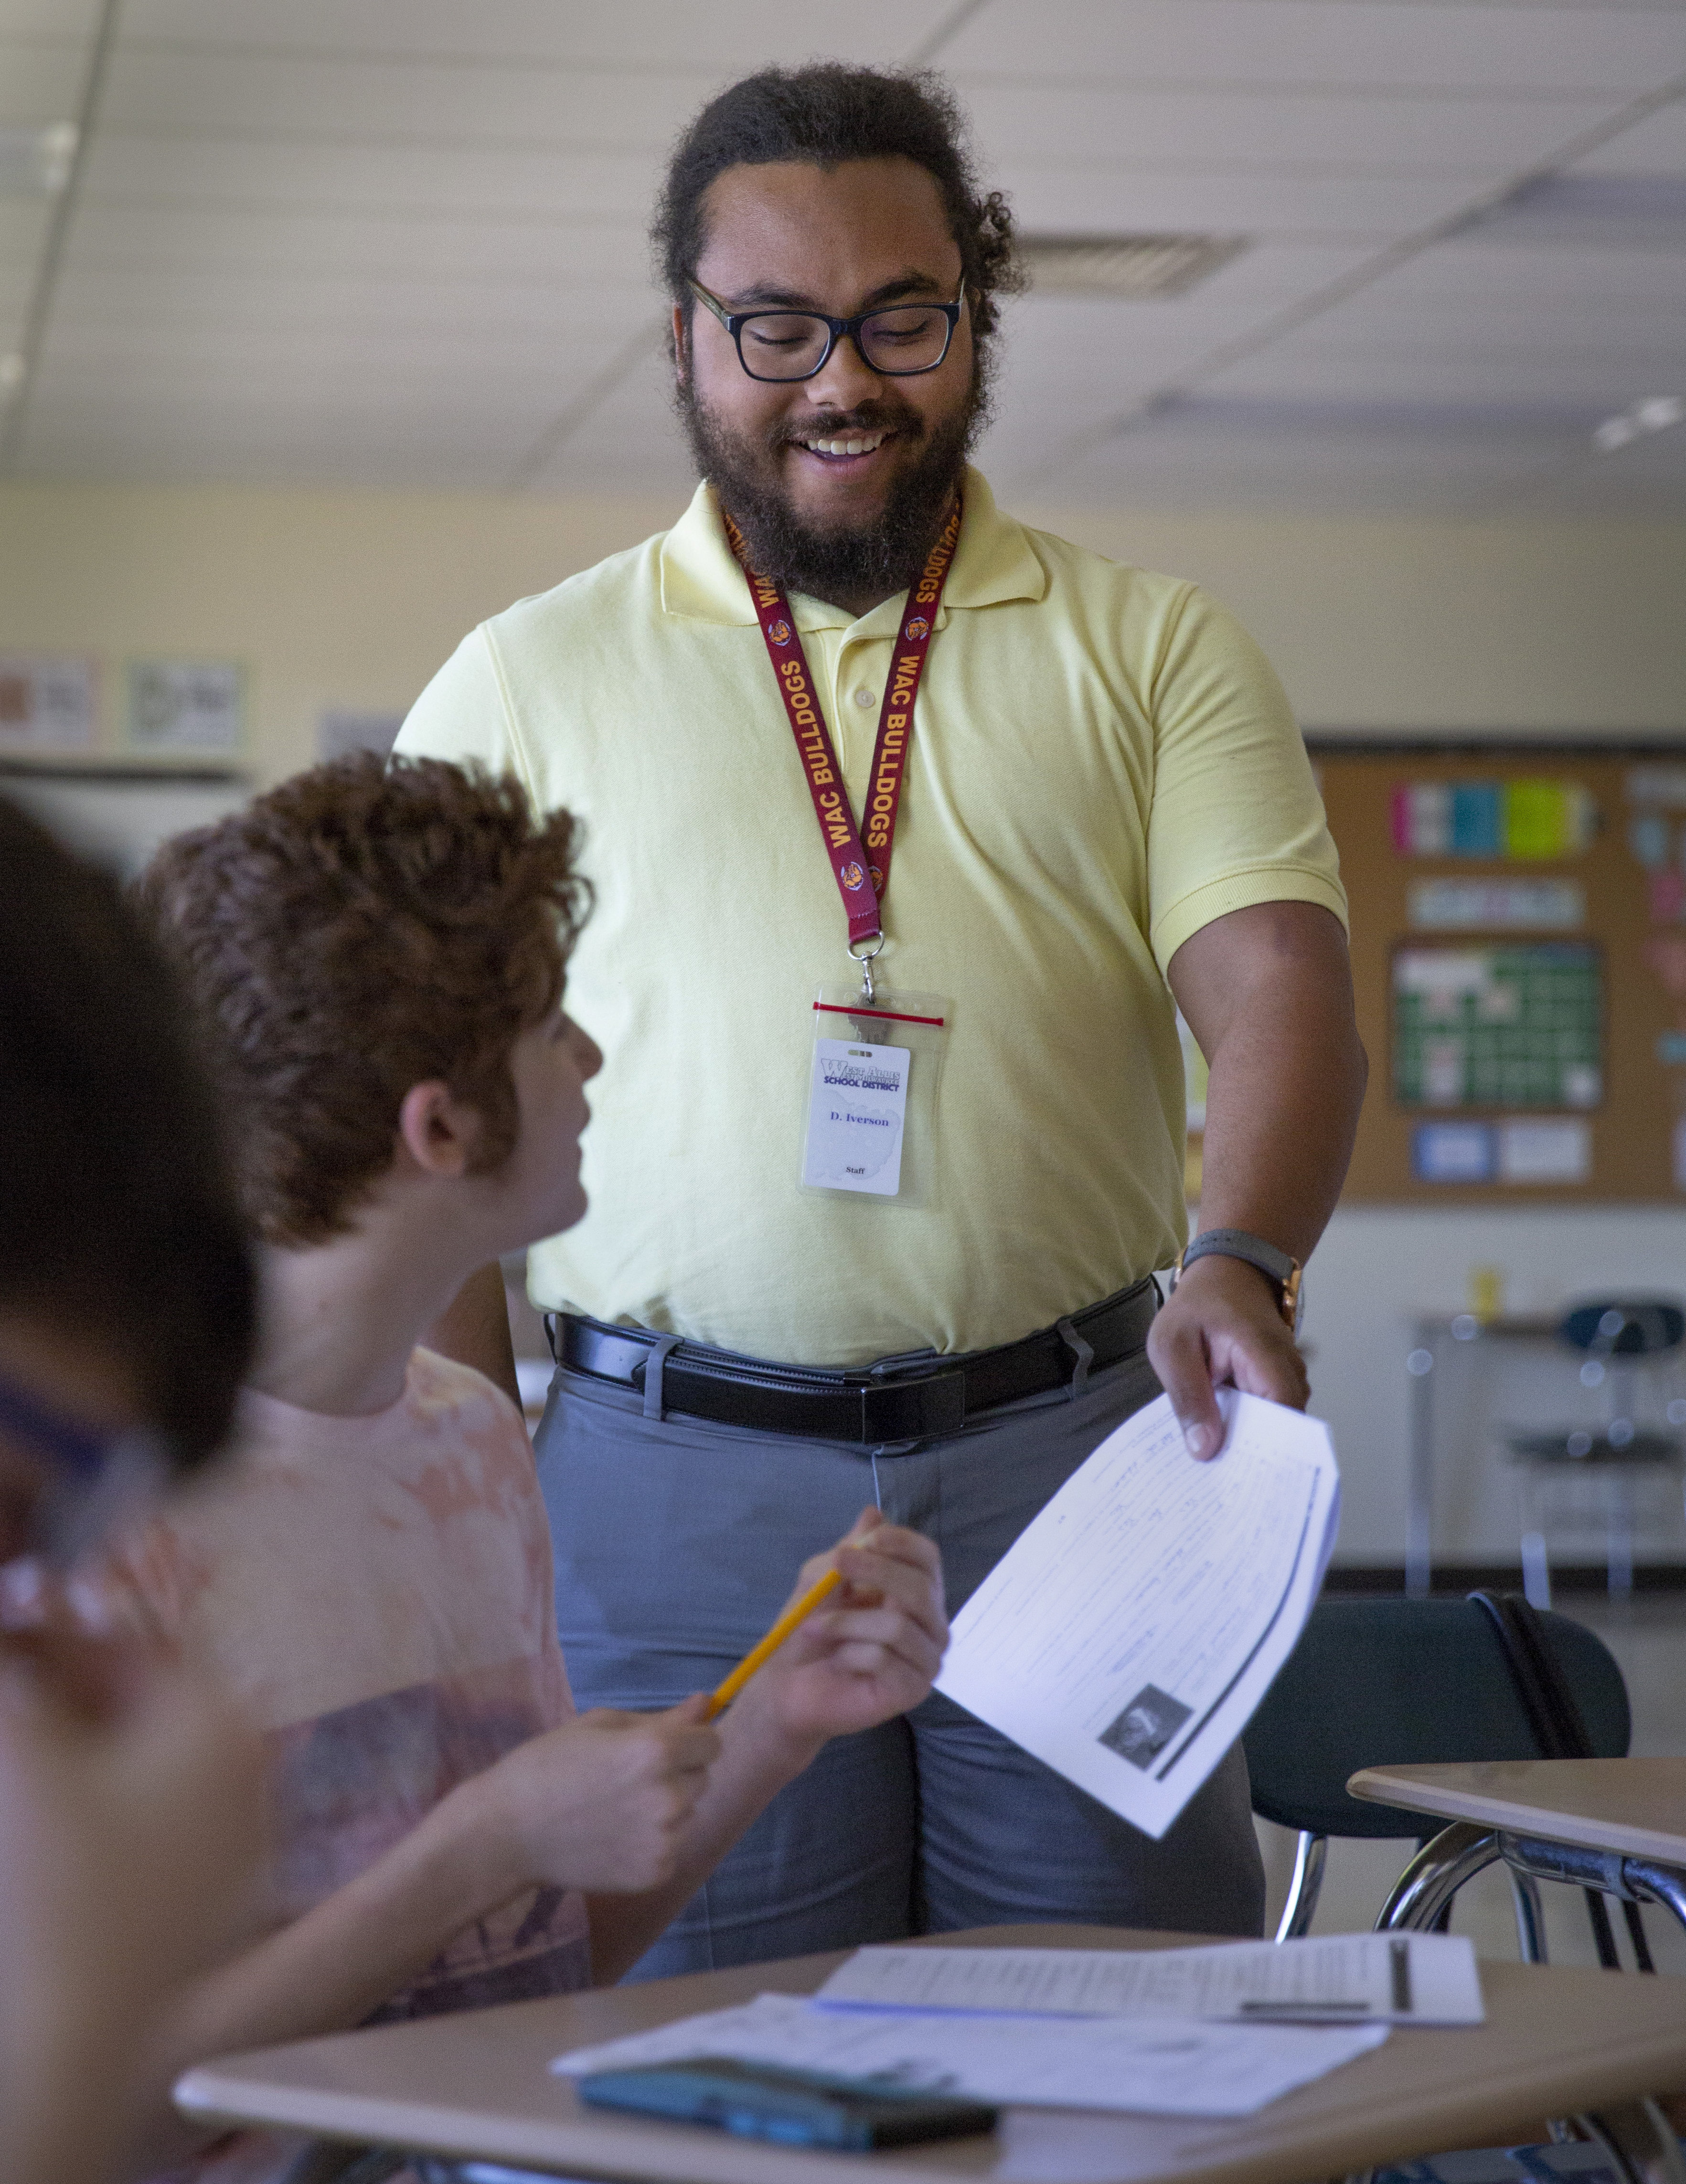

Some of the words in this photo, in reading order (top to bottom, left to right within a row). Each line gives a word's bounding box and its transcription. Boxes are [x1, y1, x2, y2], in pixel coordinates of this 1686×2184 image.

[891, 655, 920, 706] WAC
[781, 660, 834, 785] BULLDOGS
[867, 714, 907, 847] BULLDOGS
[820, 791, 852, 848] WAC
[824, 1076, 860, 1087] SCHOOL
[862, 1080, 899, 1092] DISTRICT
[831, 1111, 842, 1121] D.
[846, 1113, 889, 1126] Iverson
